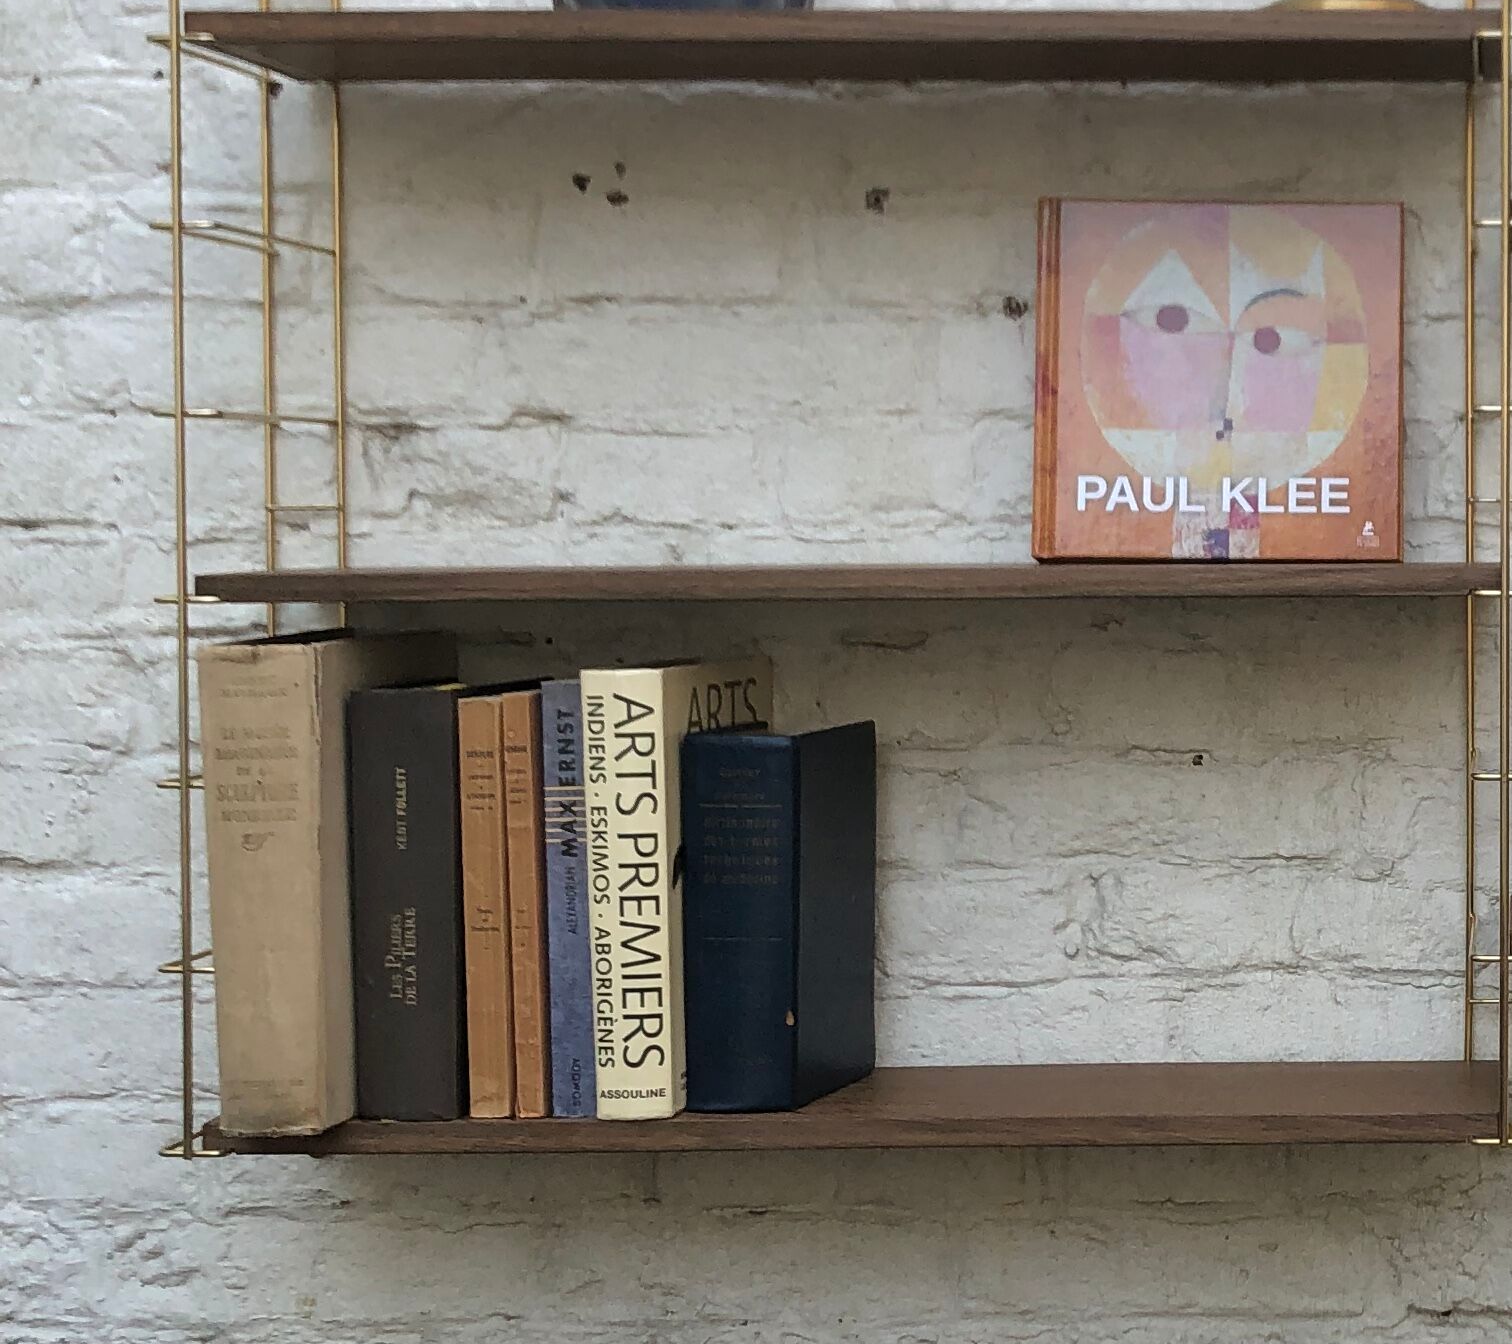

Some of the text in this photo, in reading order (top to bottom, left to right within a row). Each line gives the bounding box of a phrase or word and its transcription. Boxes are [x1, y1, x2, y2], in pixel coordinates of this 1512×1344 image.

[1076, 474, 1351, 514] PAUL KLEE
[687, 676, 757, 732] ARTS
[557, 708, 579, 858] MAX ERNST
[586, 695, 616, 1069] INDIENS ESKIMOS ABORIGÈNES
[612, 692, 666, 1069] ARTS PREMIERS
[402, 906, 417, 959] TERRE
[599, 1087, 667, 1100] ASSOULINE
